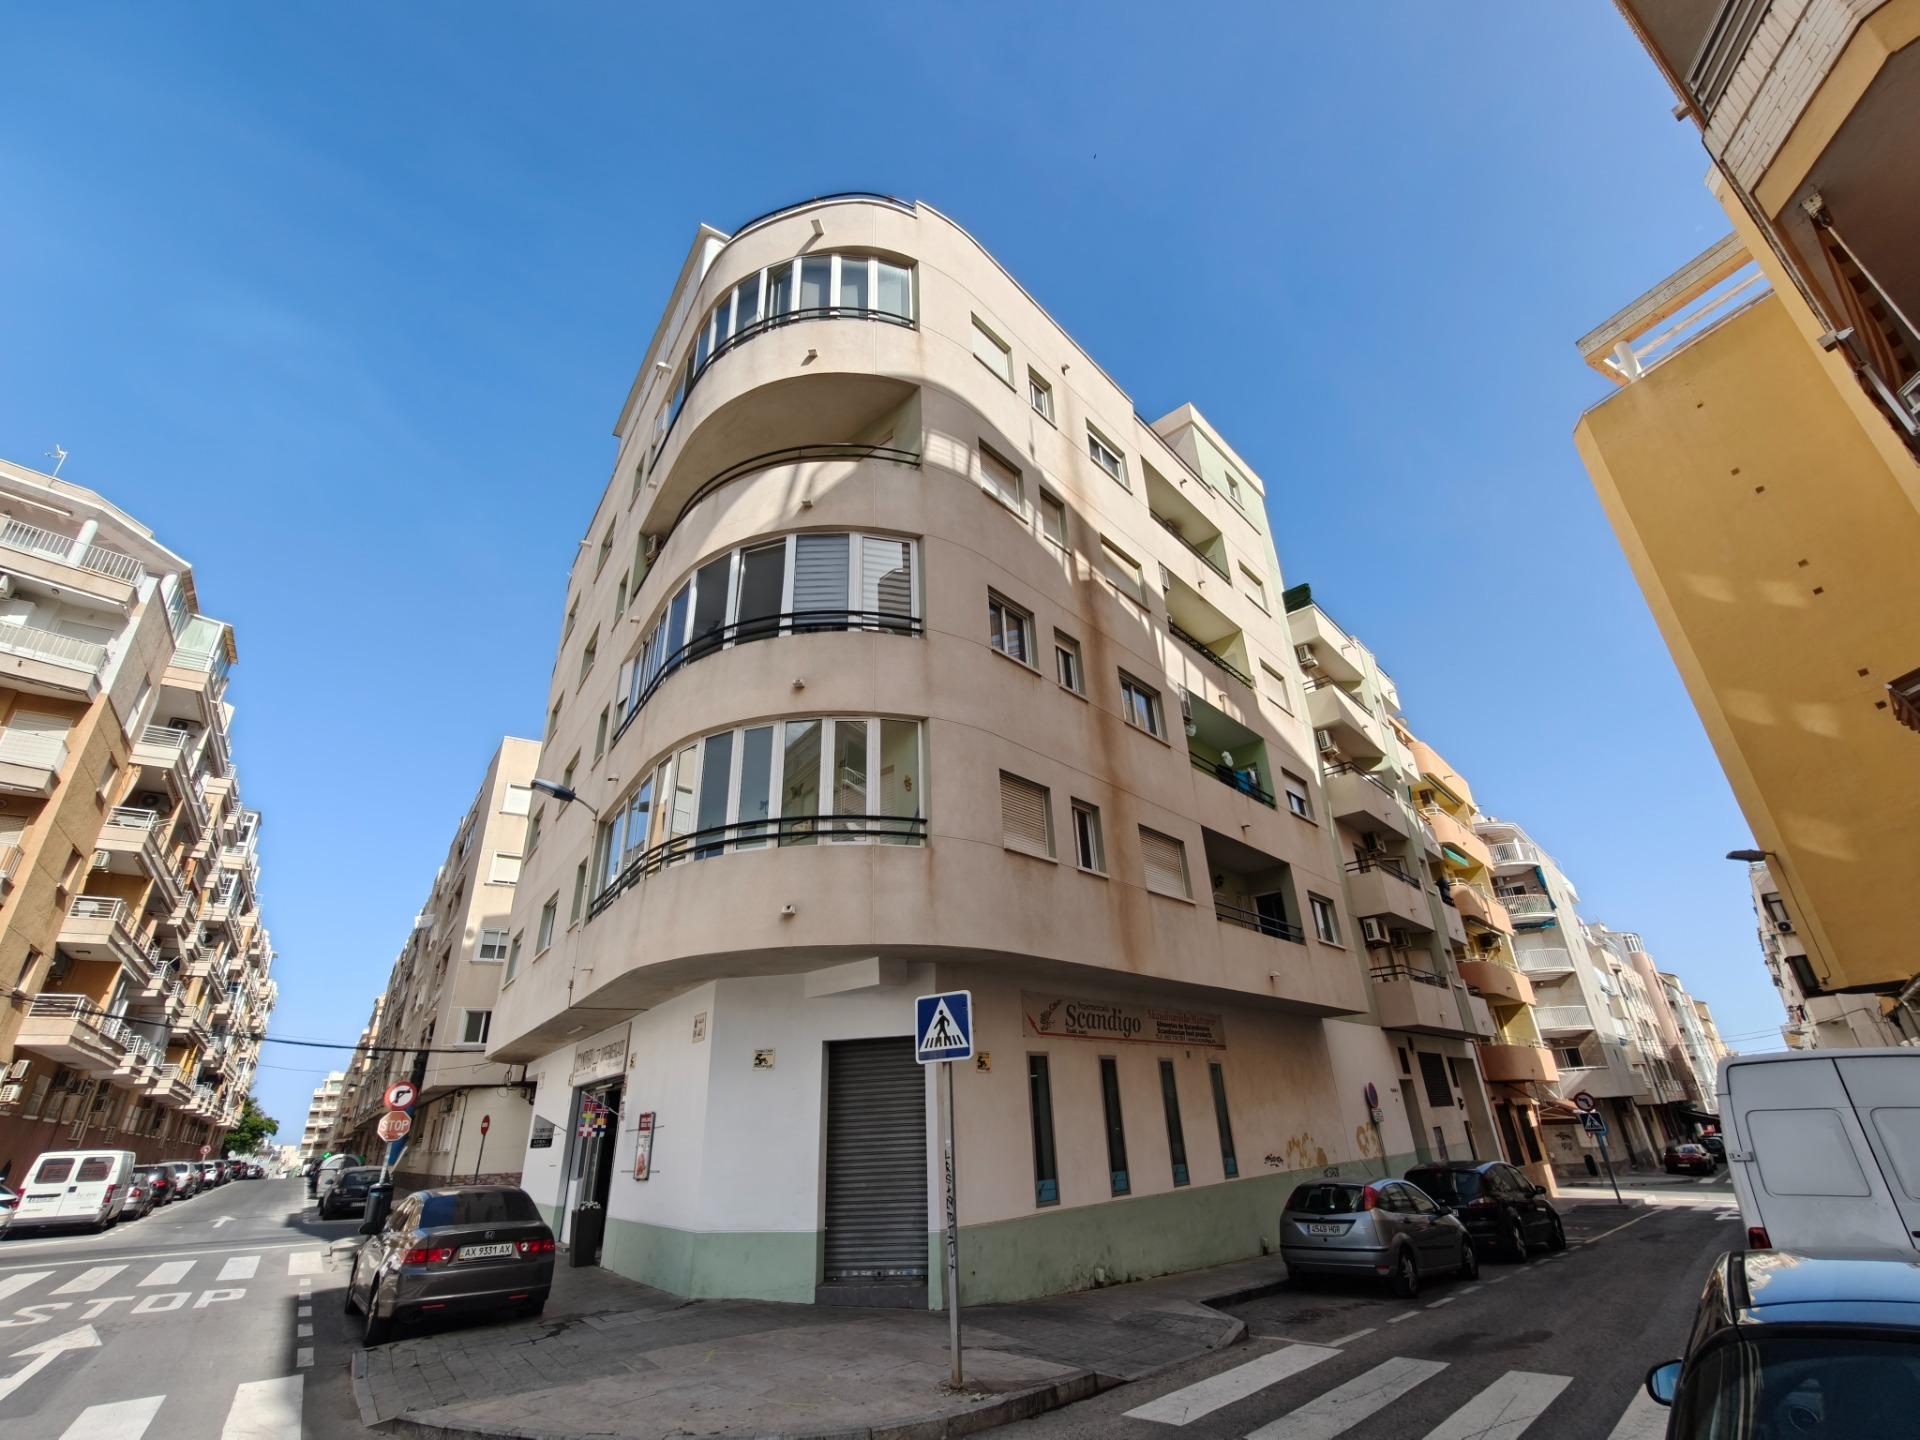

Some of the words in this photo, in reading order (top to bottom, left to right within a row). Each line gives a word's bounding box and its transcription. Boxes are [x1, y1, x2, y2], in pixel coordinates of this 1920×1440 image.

[1065, 1004, 1141, 1038] Scandigo
[381, 1119, 410, 1132] STOP
[464, 1248, 476, 1257] AX
[479, 1246, 498, 1256] 9331
[499, 1244, 511, 1254] AX
[0, 1288, 247, 1328] STOP
